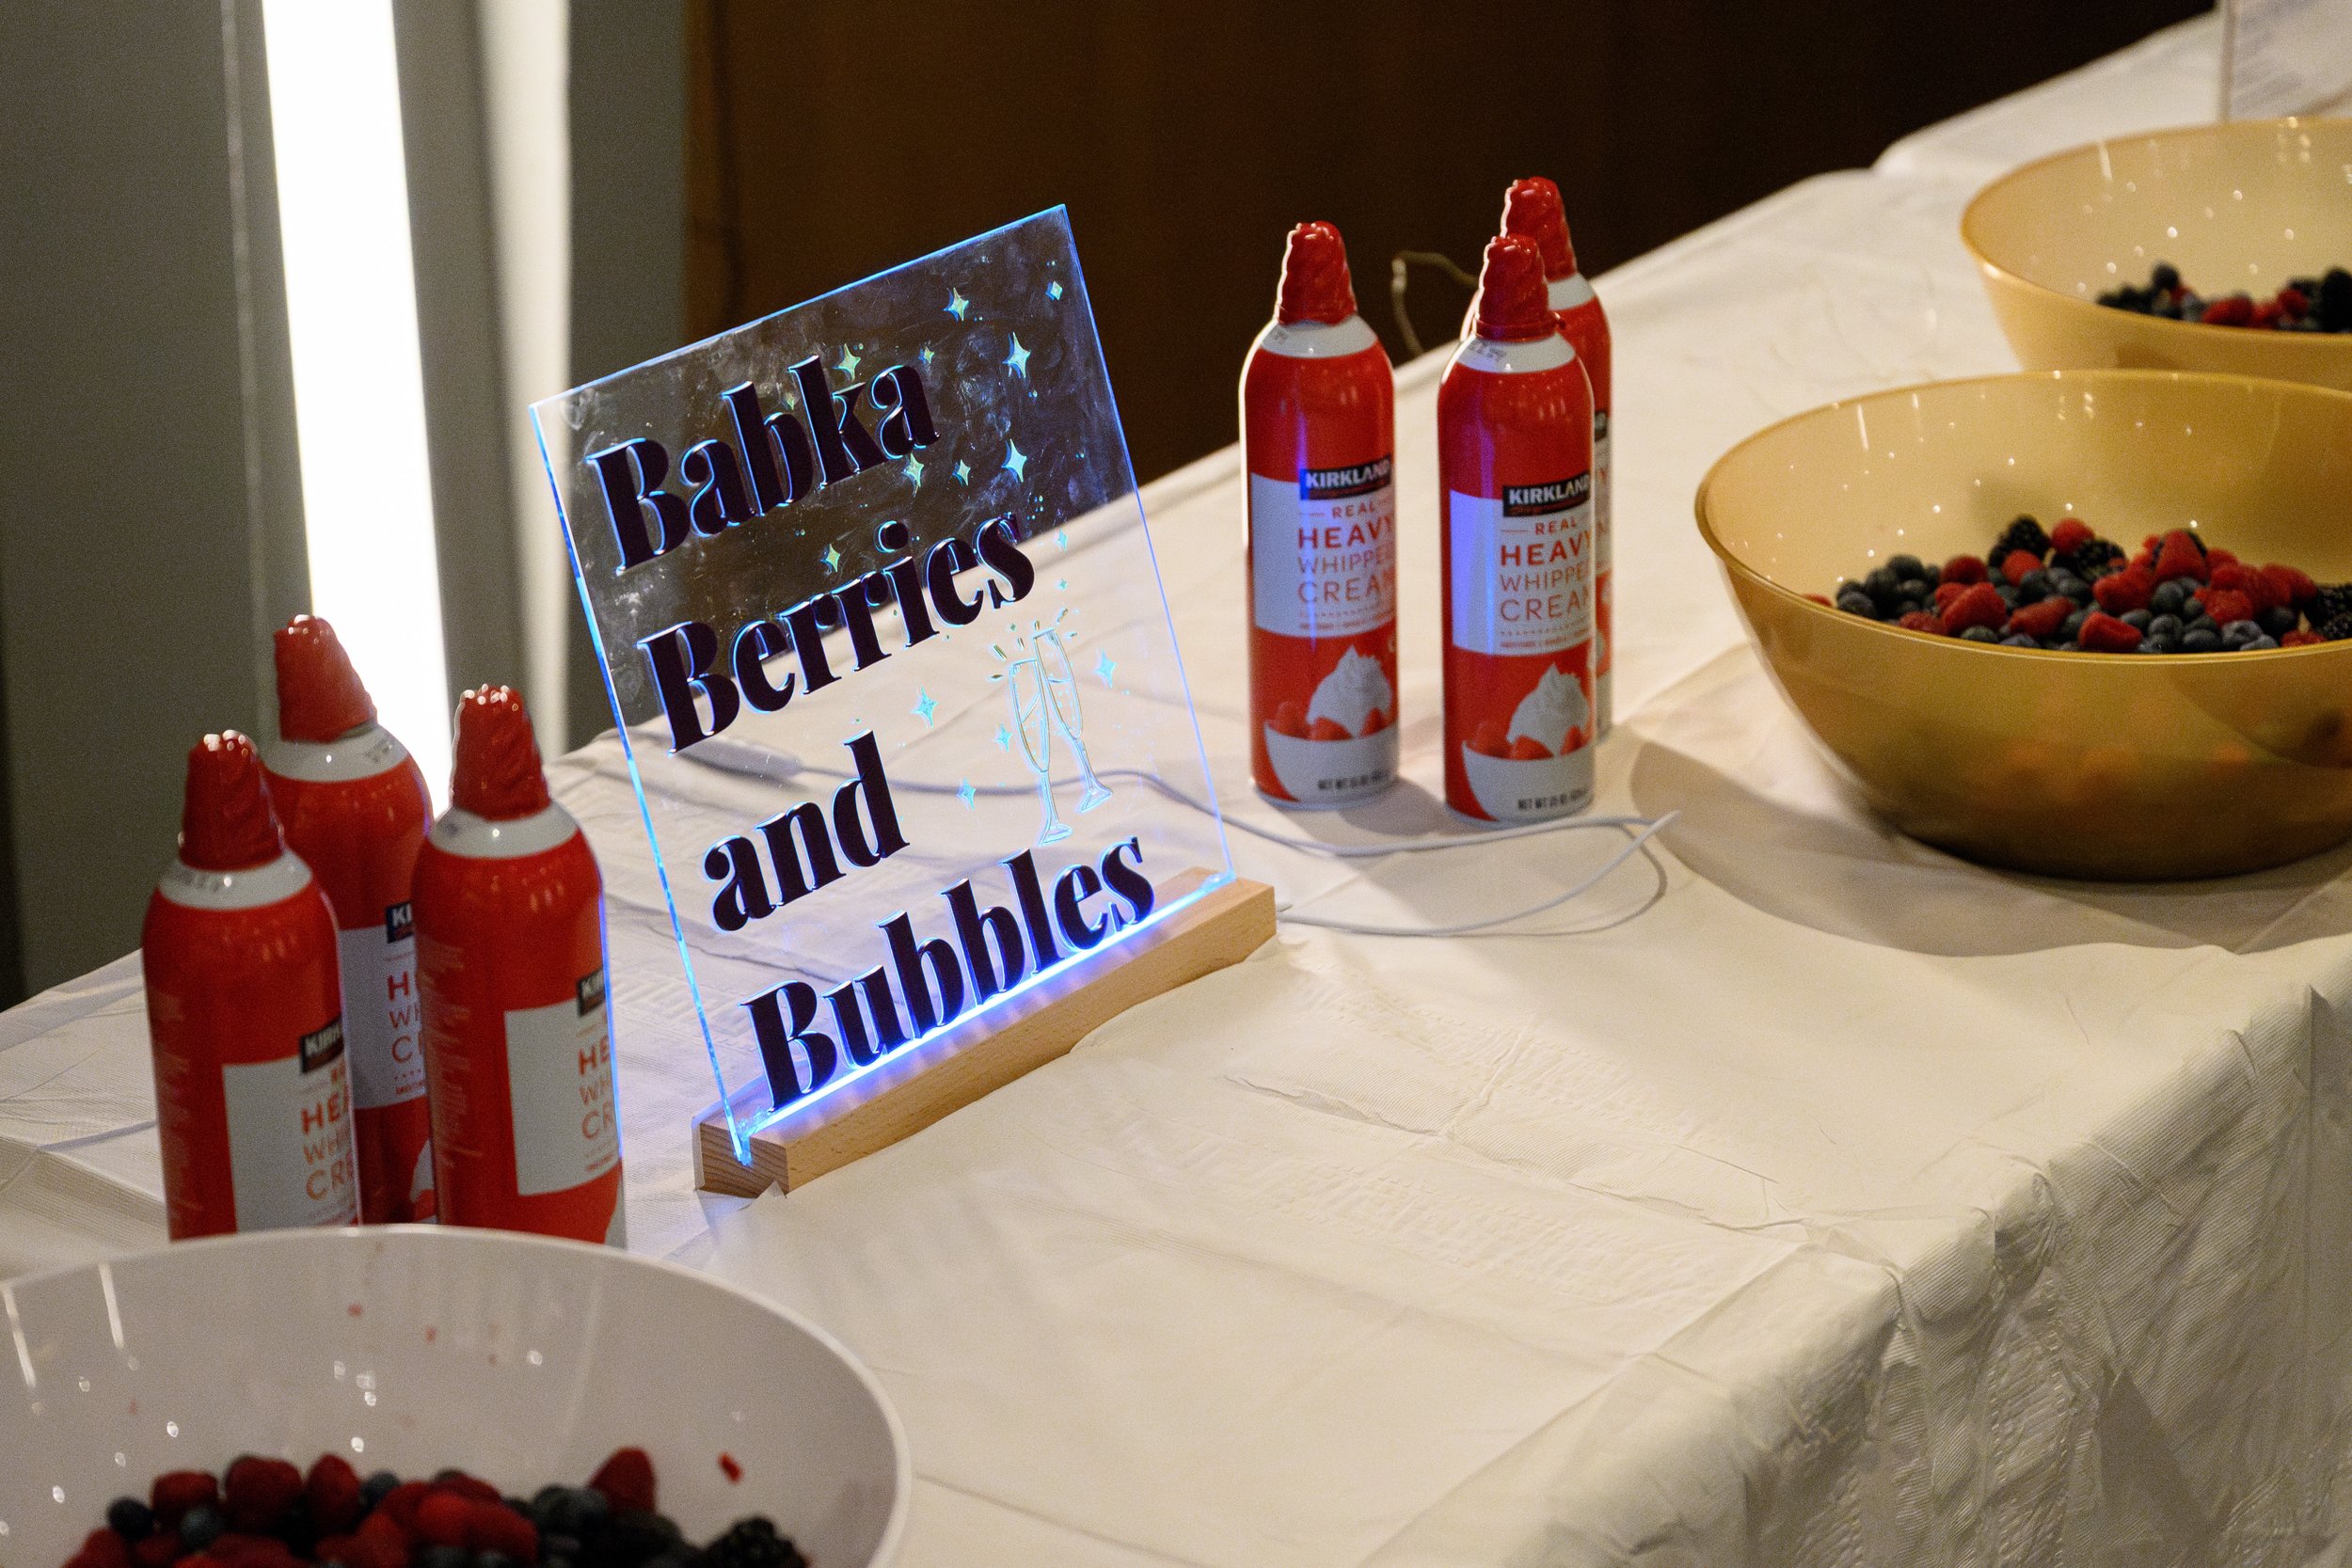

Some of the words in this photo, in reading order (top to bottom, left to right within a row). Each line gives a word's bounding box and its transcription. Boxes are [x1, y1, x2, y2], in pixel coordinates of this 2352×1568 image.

[587, 355, 938, 576] Babka
[1332, 500, 1375, 517] REAL
[1535, 517, 1577, 534] REAL
[637, 512, 1036, 754] Berries
[1500, 562, 1590, 592] WHIPPE
[702, 731, 909, 933] and
[739, 836, 1155, 1113] Bubbles
